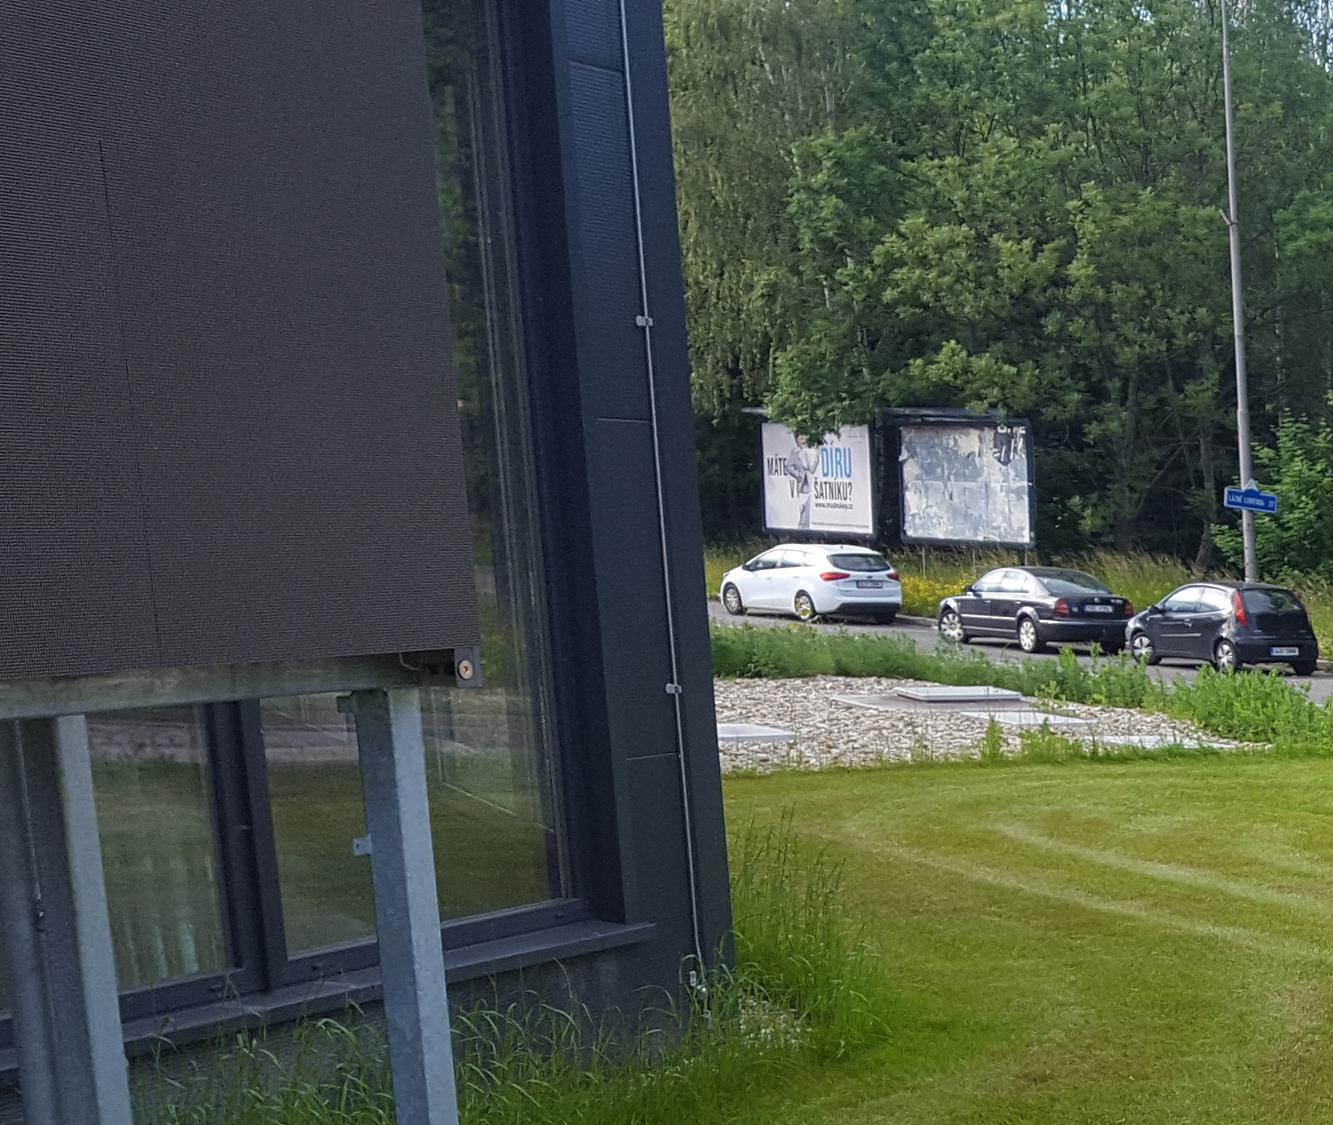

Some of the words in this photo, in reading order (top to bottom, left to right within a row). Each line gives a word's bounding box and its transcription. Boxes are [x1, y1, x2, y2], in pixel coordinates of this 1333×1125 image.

[767, 453, 788, 476] MÁTE
[821, 440, 852, 478] DÍRU
[814, 477, 853, 501] ŠATNÍKU?
